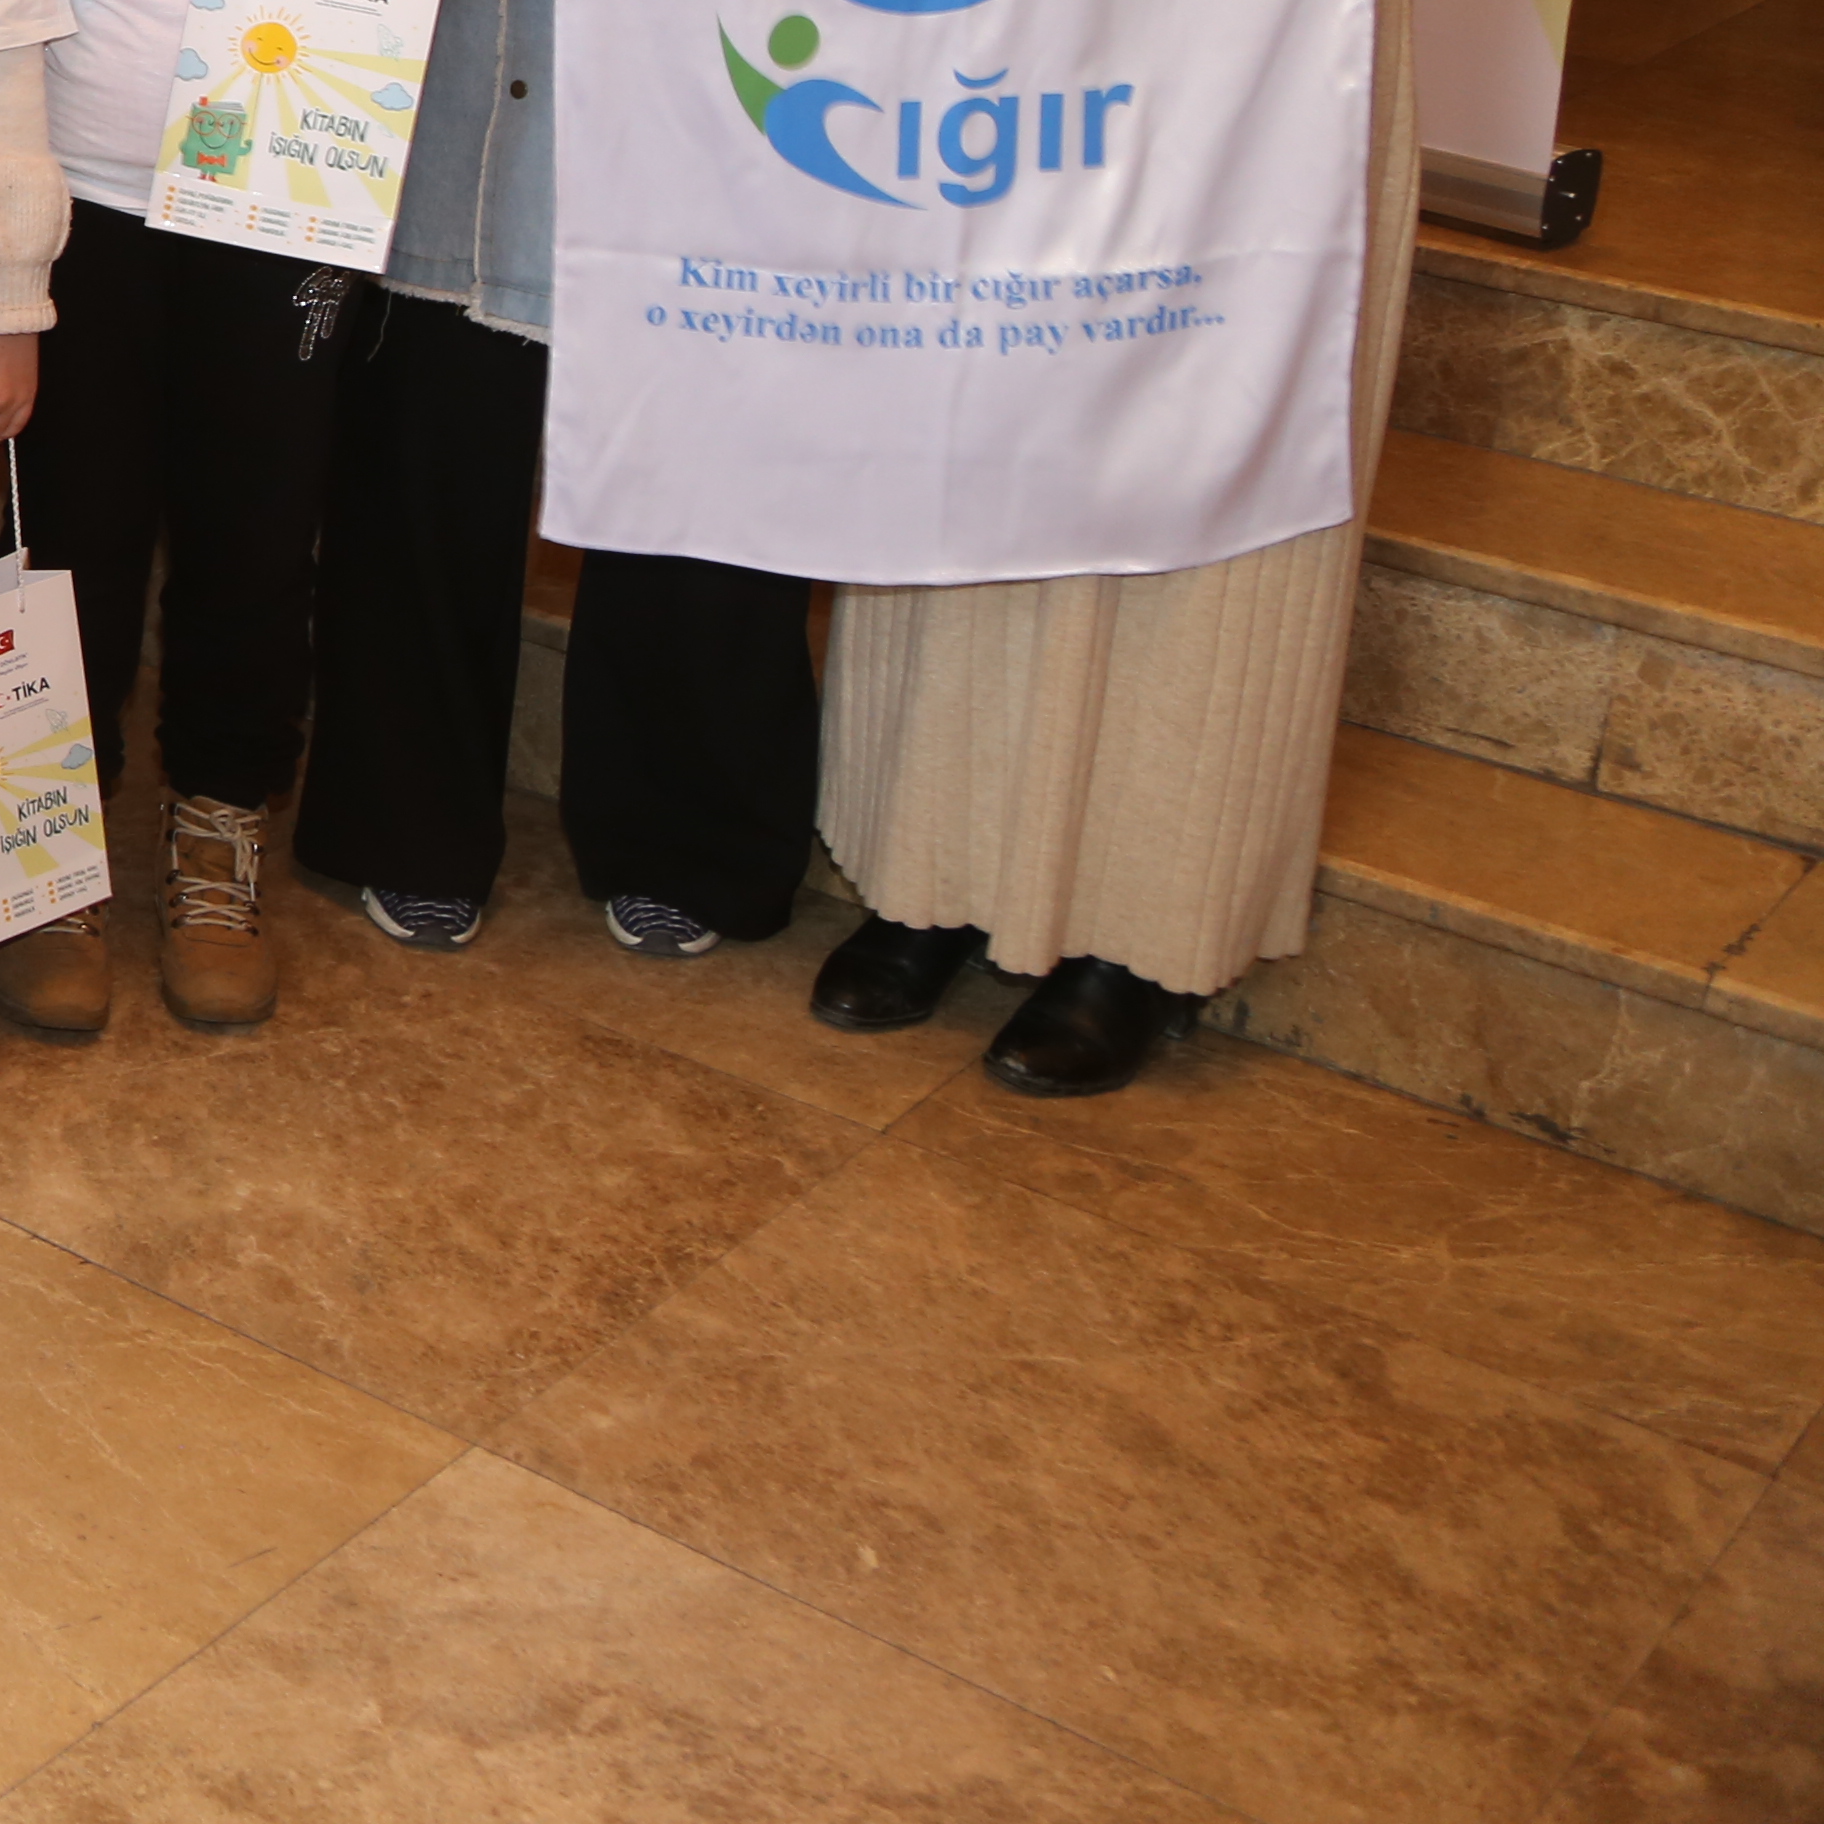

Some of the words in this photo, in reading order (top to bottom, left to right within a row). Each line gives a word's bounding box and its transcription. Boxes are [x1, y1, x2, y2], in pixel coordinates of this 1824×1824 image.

[300, 106, 370, 144] KİTABIN
[268, 132, 319, 167] İŞIĞIN
[325, 146, 389, 181] OLSUN
[678, 257, 761, 294] Kim
[772, 270, 893, 310] xeyirli
[904, 270, 962, 306] bir
[971, 264, 1062, 311] cığır
[645, 304, 669, 327] o
[678, 307, 843, 346] xeyirdən
[855, 322, 925, 350] ona
[938, 318, 986, 350] da
[998, 321, 1070, 357] pay
[12, 676, 51, 702] TİKA
[0, 824, 39, 855] İŞIĞIN
[43, 803, 91, 839] OLSUN
[15, 785, 69, 824] KİTABIN
